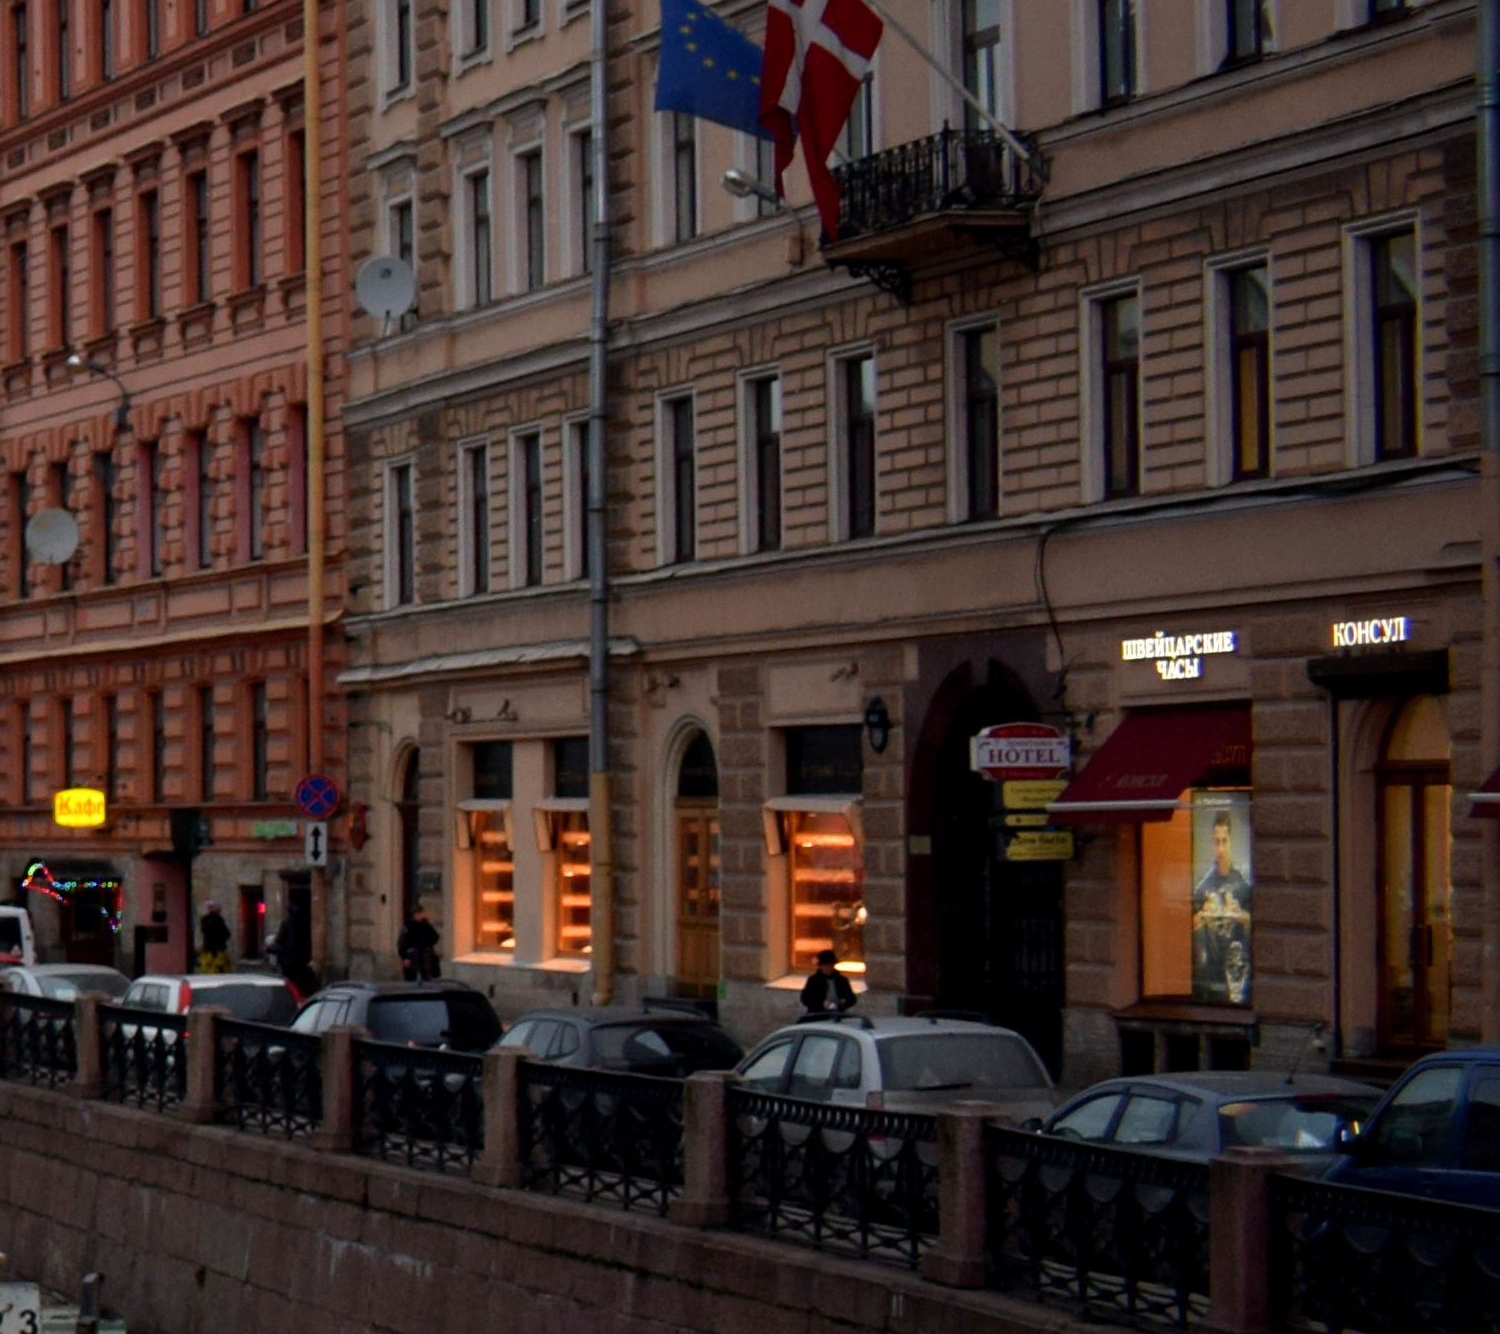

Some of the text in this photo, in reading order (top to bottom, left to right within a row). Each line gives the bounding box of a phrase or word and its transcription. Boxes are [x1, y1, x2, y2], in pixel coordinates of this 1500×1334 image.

[1332, 618, 1407, 646] КОНСУЛ
[1122, 631, 1235, 660] ШВЕЙЦАРСКИЕ
[1156, 657, 1201, 679] ЧАСЫ
[988, 748, 1061, 764] HOTEL
